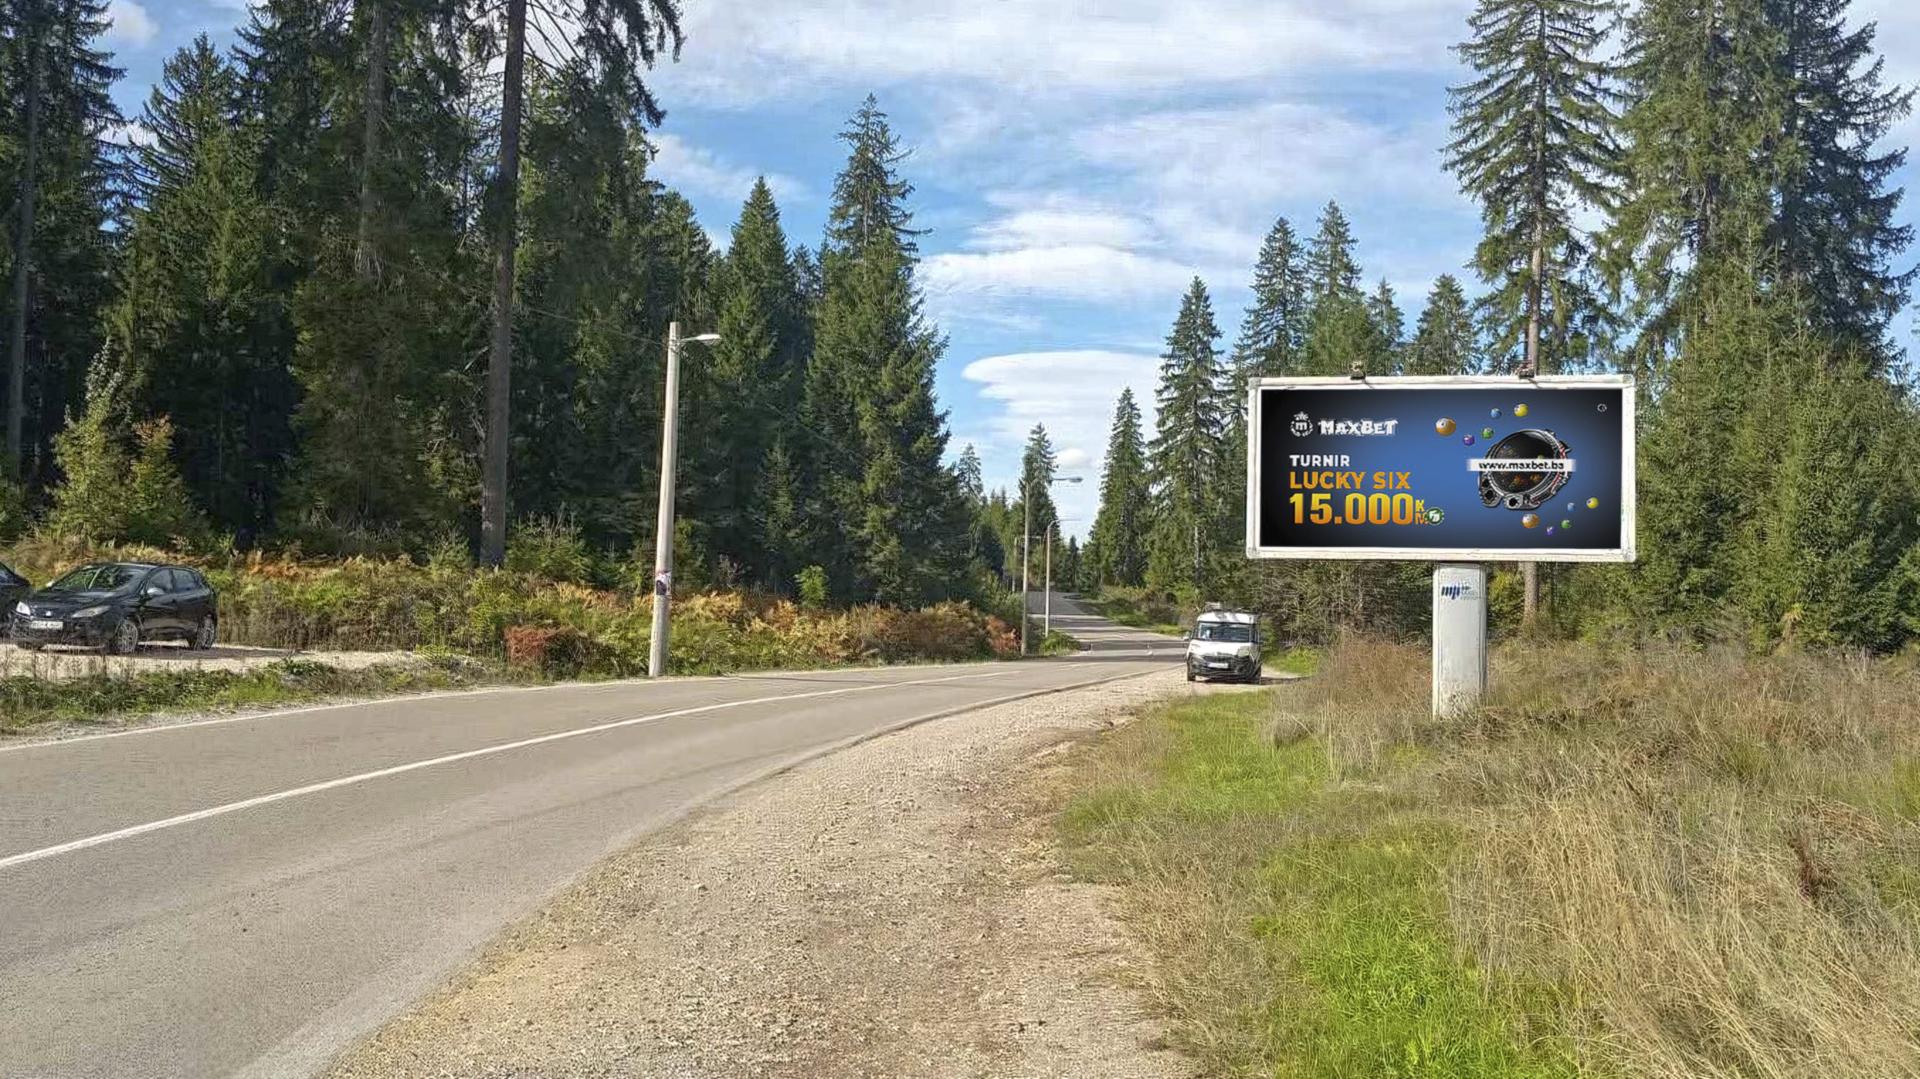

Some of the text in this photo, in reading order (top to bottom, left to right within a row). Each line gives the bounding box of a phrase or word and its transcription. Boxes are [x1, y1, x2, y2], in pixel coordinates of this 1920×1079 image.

[1289, 455, 1351, 467] TURNIR
[1479, 461, 1565, 470] www.maxbet.ba
[1289, 471, 1412, 489] LUCKY SIX
[1289, 493, 1414, 525] 15.000
